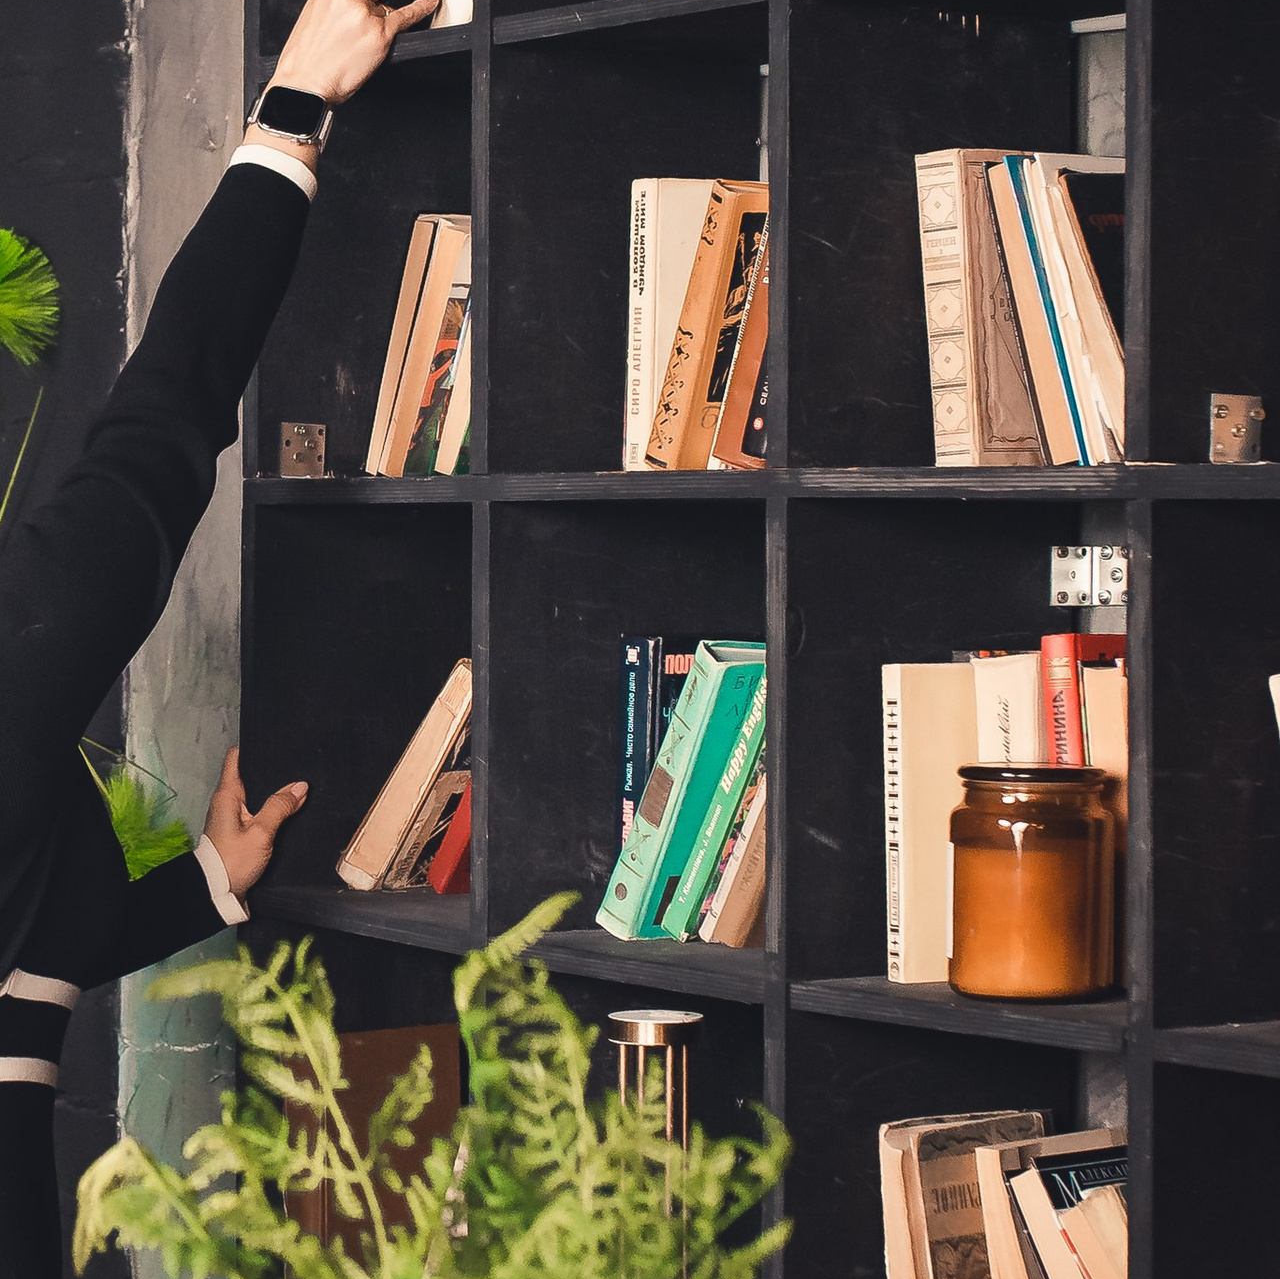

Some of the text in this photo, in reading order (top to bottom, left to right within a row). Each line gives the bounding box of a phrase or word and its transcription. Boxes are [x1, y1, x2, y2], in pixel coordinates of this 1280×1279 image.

[632, 199, 640, 278] БОЛЬШОМ
[638, 236, 646, 296] ЧУЖДОМ
[631, 306, 643, 415] СИРО АЛЕГРИЯ
[628, 672, 636, 690] дело
[665, 654, 694, 674] ПОЛ
[627, 690, 635, 732] семейное
[1052, 690, 1068, 765] РИНИНА
[626, 734, 634, 757] Чисто
[721, 737, 748, 796] Happy
